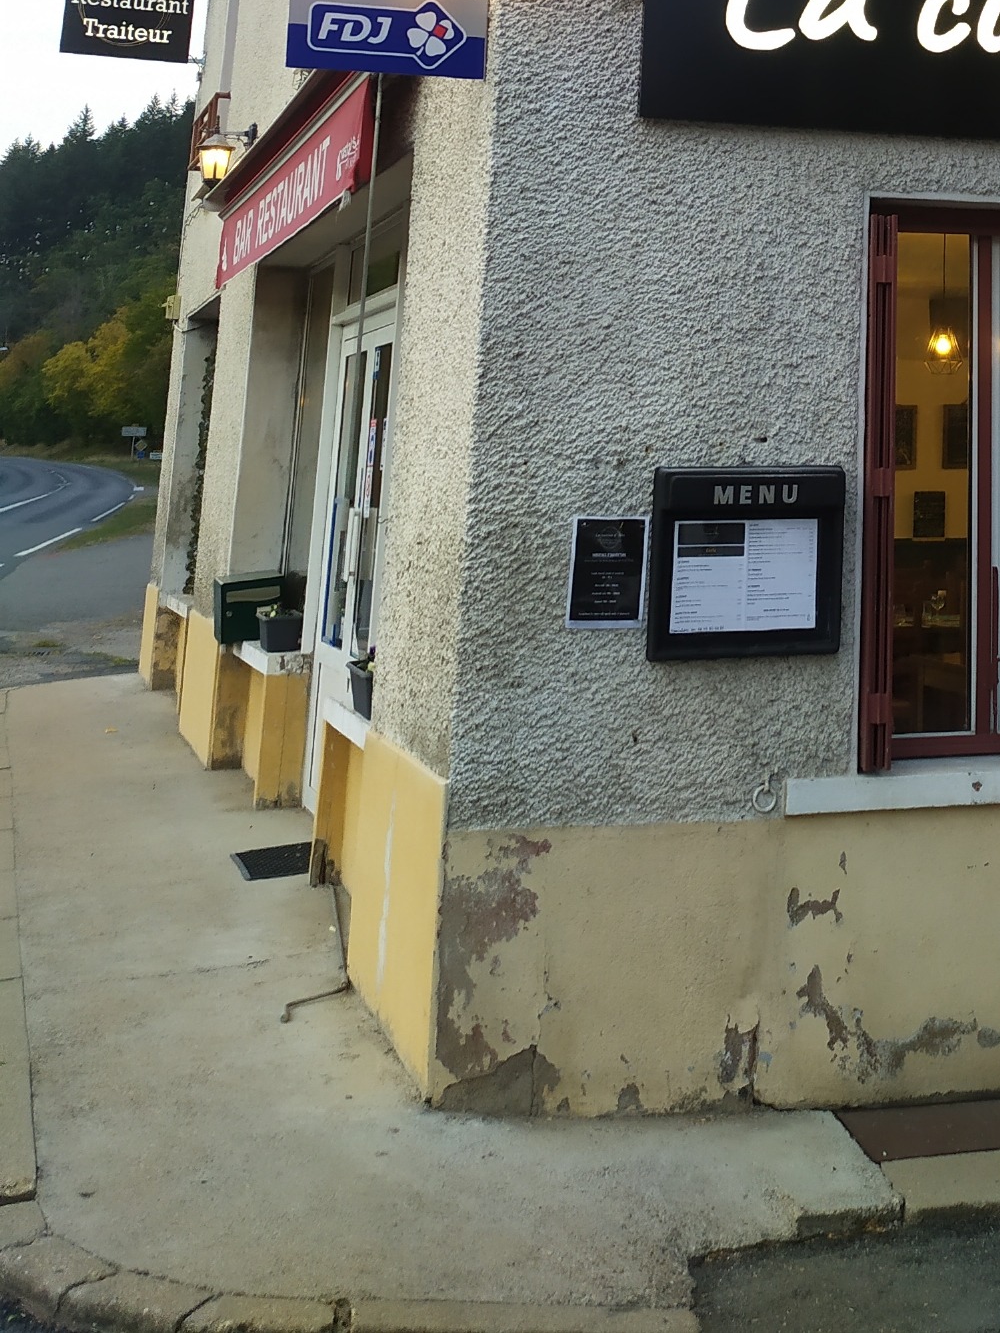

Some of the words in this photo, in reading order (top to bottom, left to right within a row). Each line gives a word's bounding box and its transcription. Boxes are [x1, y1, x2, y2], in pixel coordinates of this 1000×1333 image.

[83, 17, 173, 44] Traiteur
[317, 11, 394, 44] FDJ
[232, 206, 255, 266] BAR
[254, 134, 331, 249] RESTAURANT
[713, 484, 799, 505] MENU
